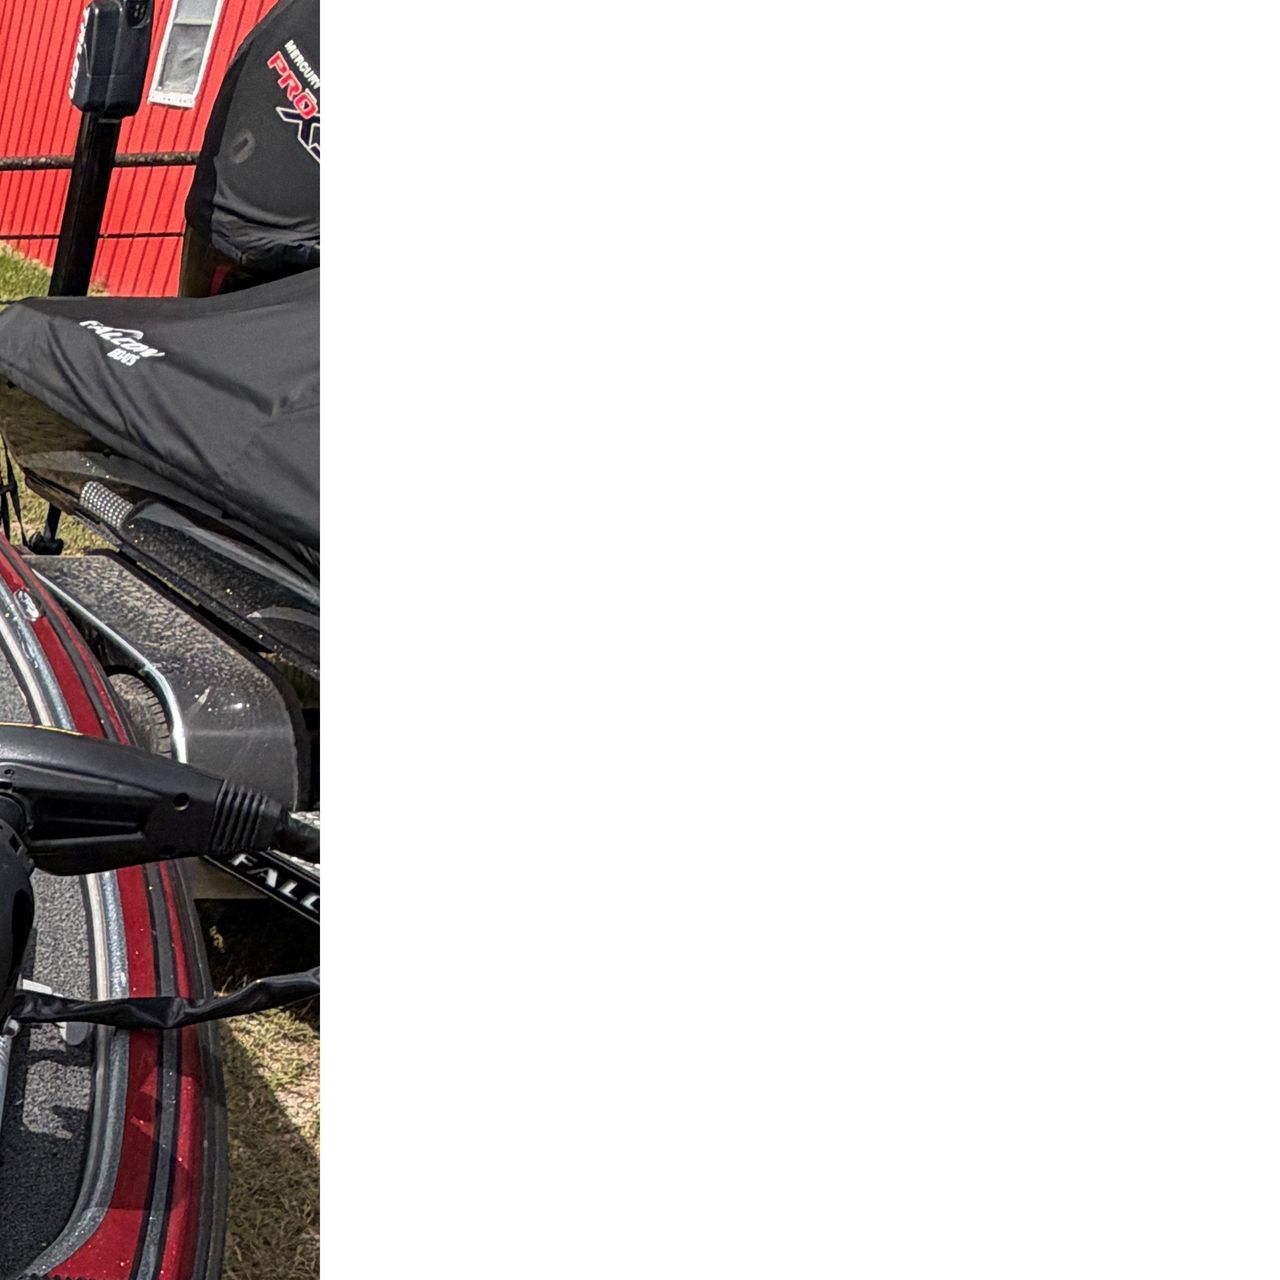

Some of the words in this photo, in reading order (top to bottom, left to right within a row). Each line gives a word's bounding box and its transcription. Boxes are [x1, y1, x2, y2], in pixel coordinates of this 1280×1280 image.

[284, 39, 320, 90] MERCURY
[275, 106, 320, 164] X
[228, 853, 320, 914] FALC
